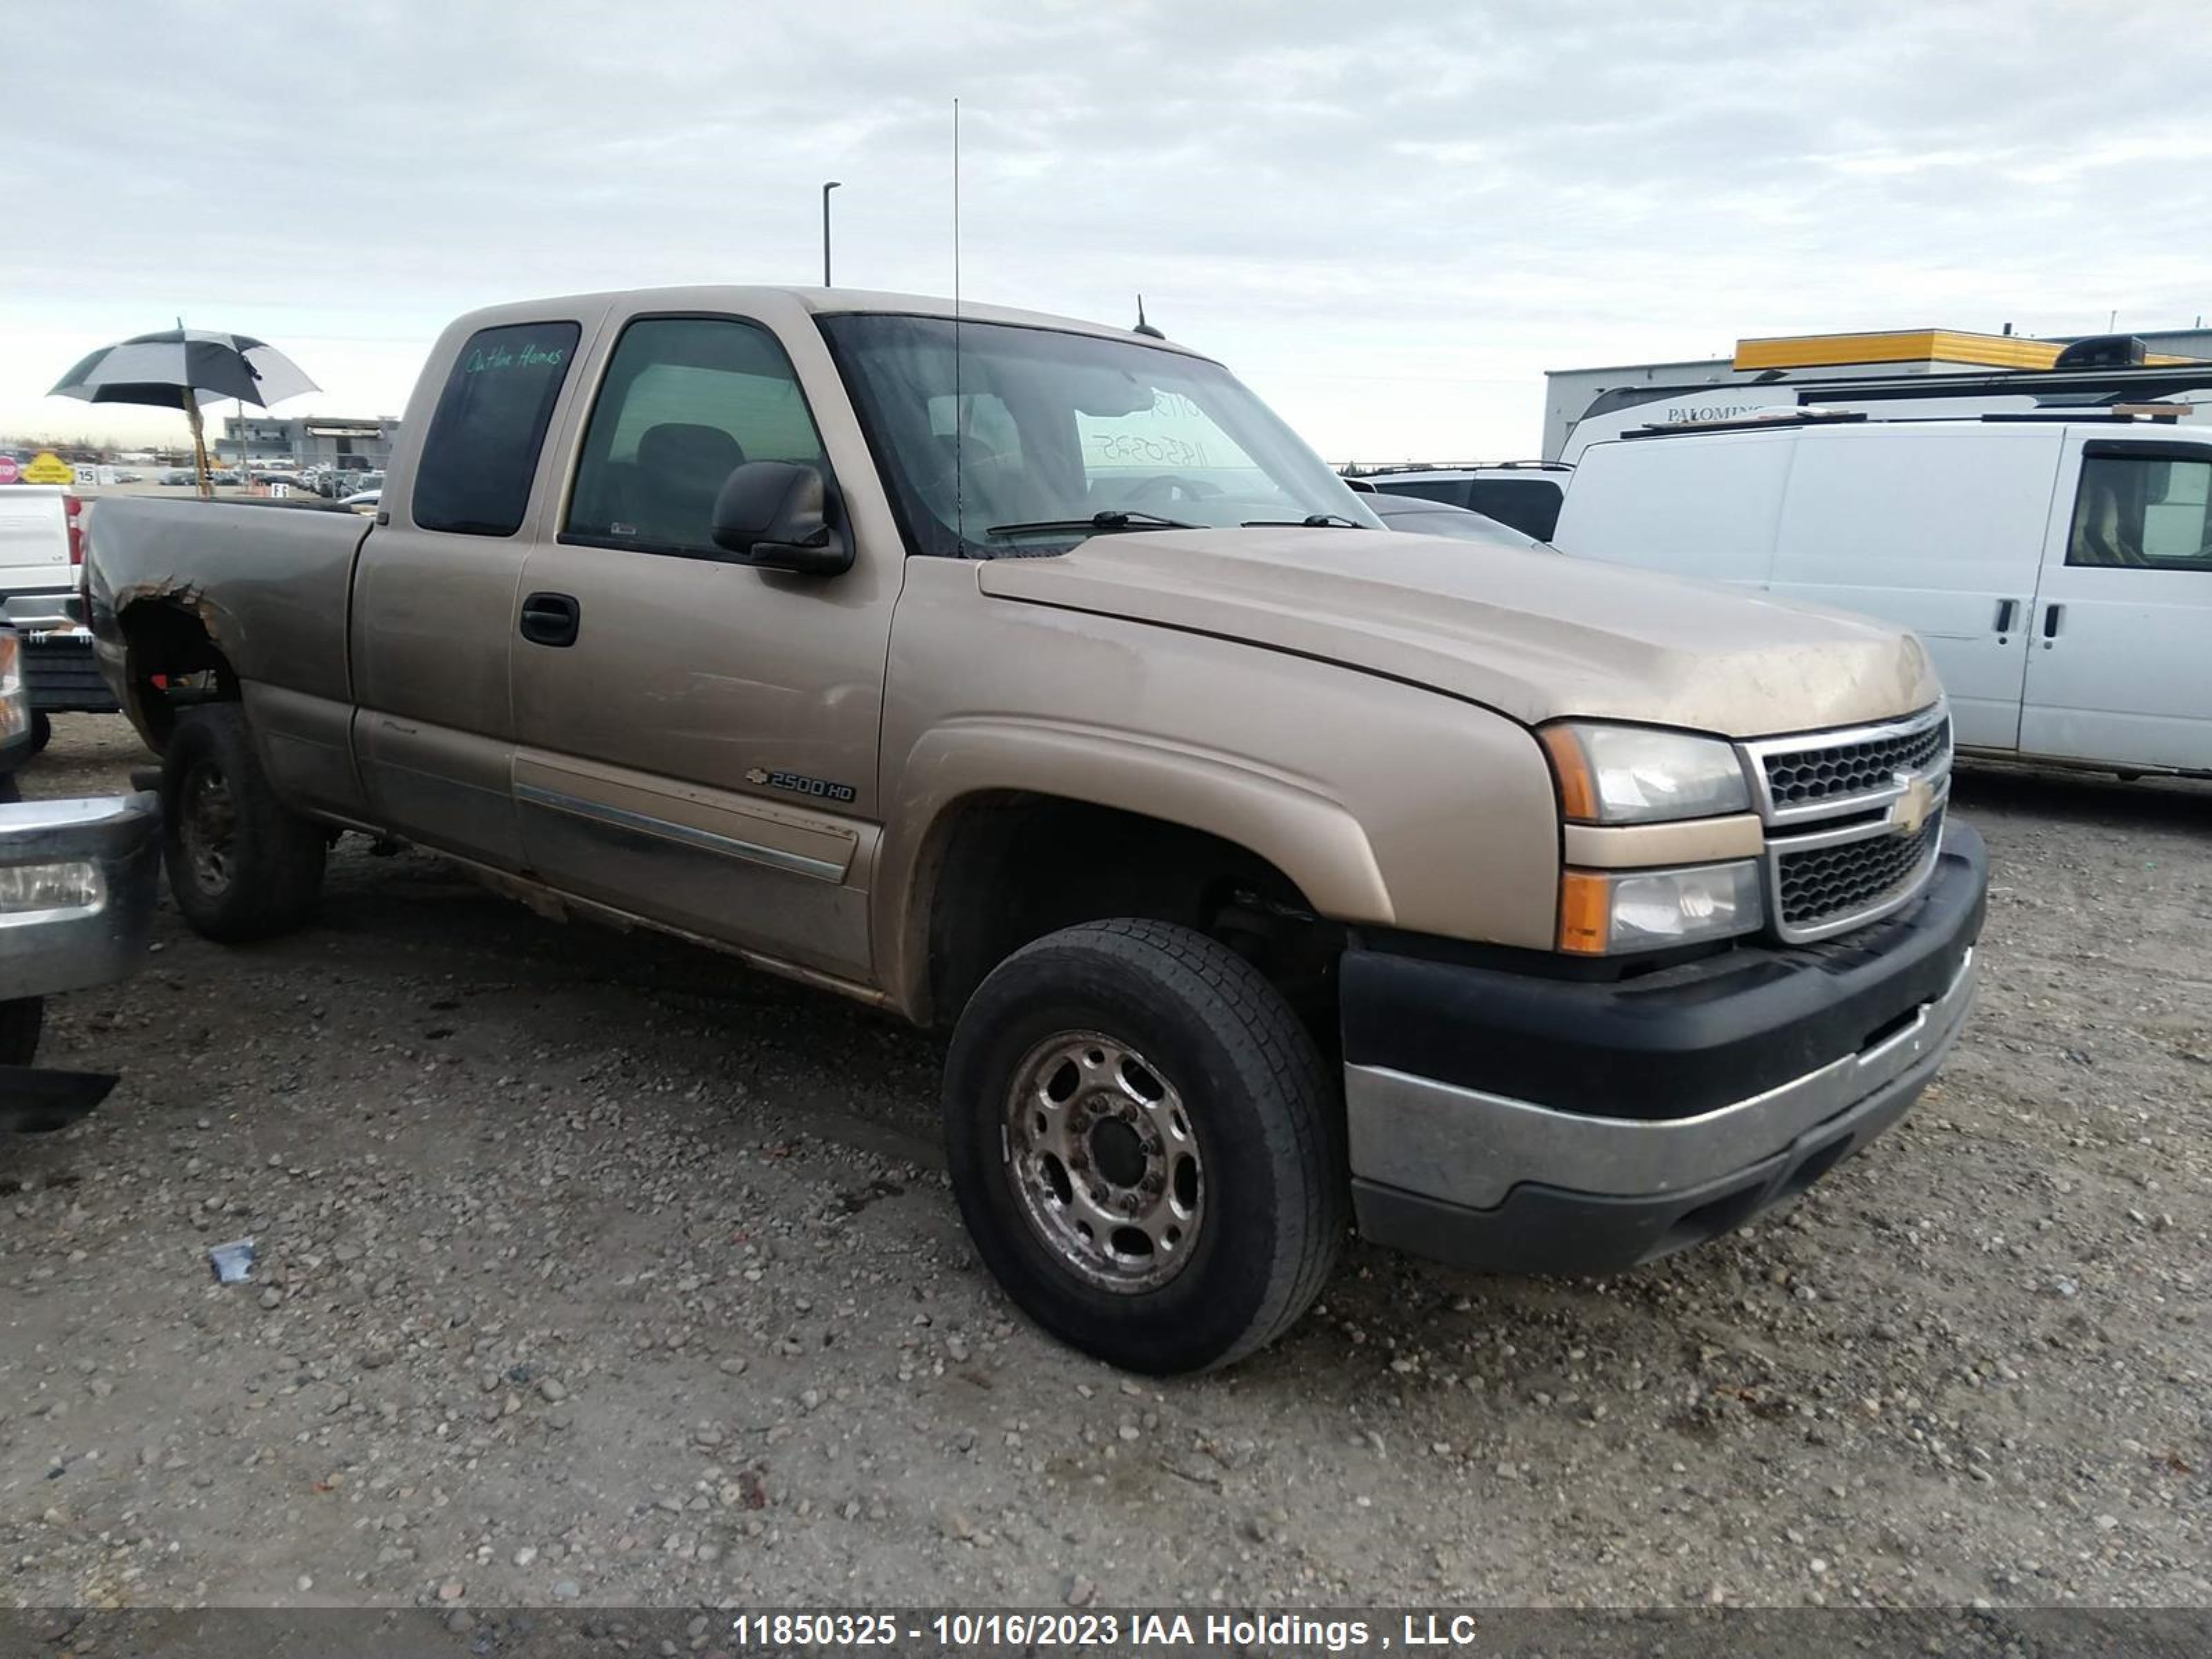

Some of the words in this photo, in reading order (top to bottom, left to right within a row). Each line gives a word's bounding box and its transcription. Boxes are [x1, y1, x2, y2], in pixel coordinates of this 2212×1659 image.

[1668, 405, 1764, 422] PALOMI
[0, 466, 16, 475] TOP
[79, 471, 93, 482] 15
[771, 773, 825, 796] 2500
[828, 784, 852, 800] HD
